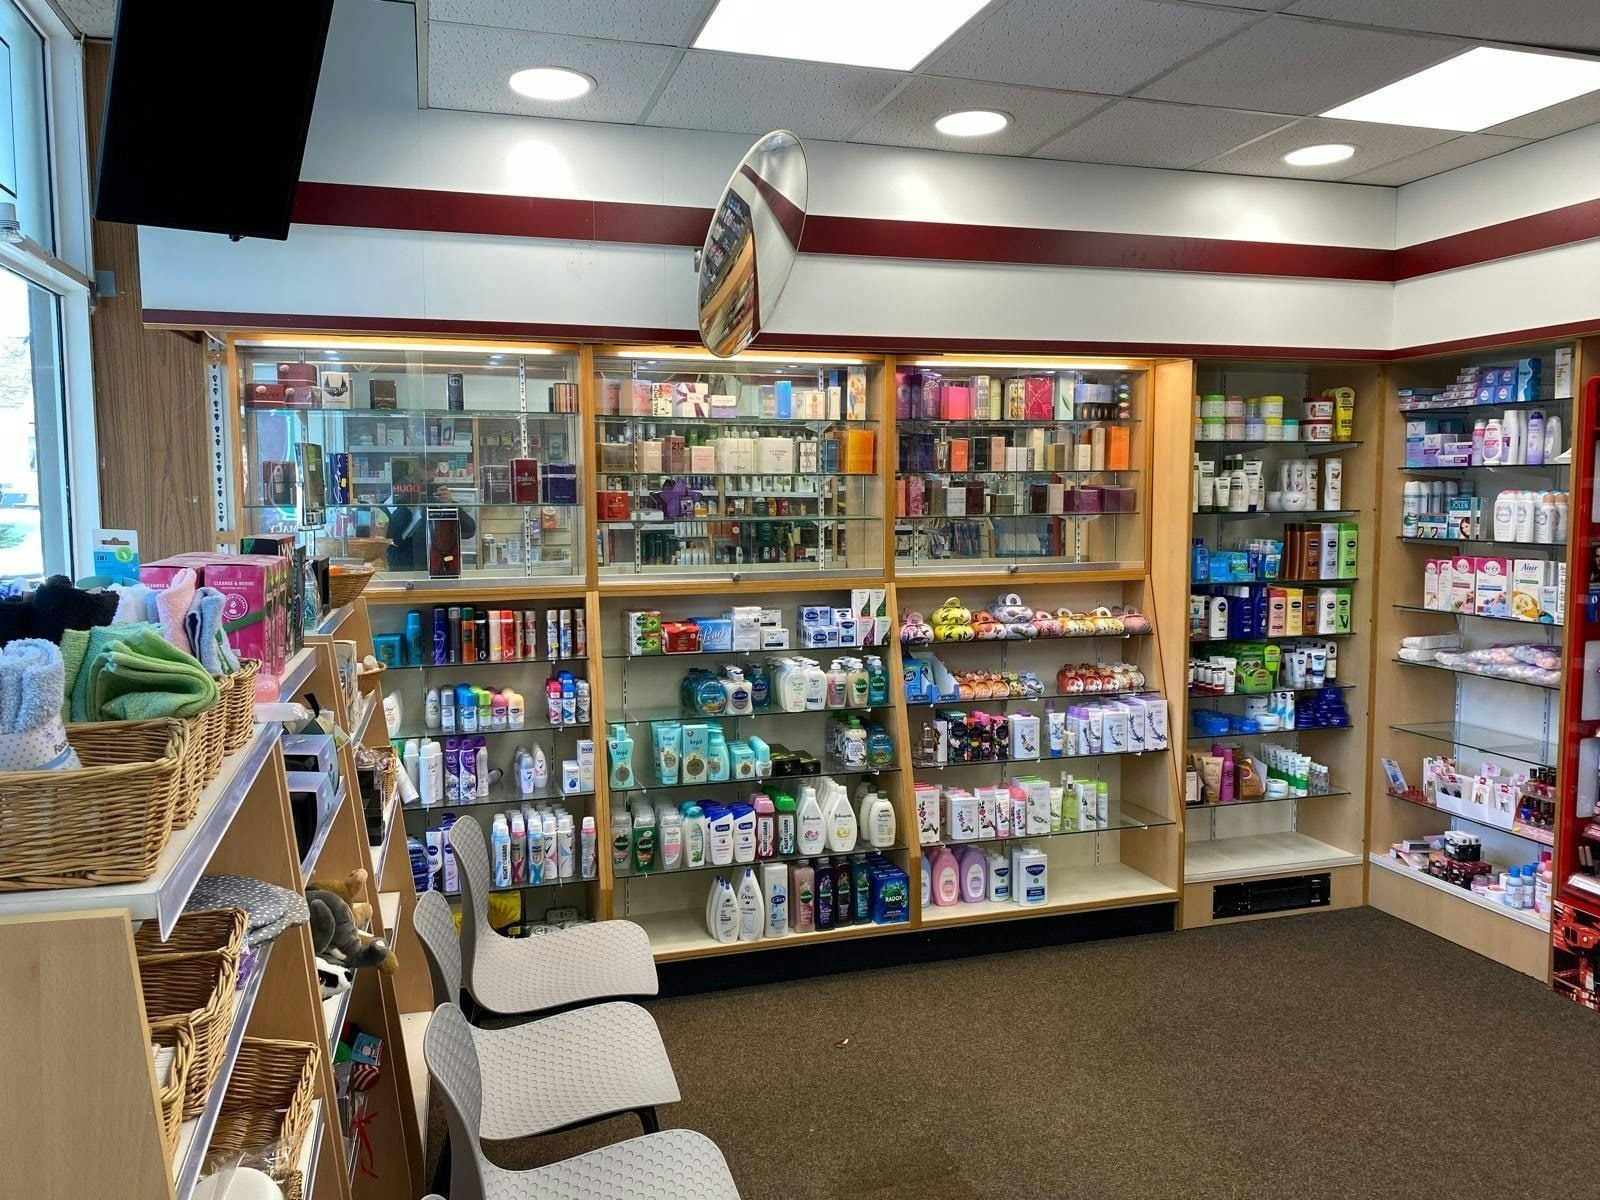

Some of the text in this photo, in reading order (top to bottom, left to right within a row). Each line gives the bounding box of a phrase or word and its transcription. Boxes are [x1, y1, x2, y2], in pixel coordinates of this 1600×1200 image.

[392, 484, 421, 493] HUGO
[1451, 501, 1469, 509] JOLEN
[1521, 562, 1538, 571] Nair
[885, 894, 903, 902] RADOX
